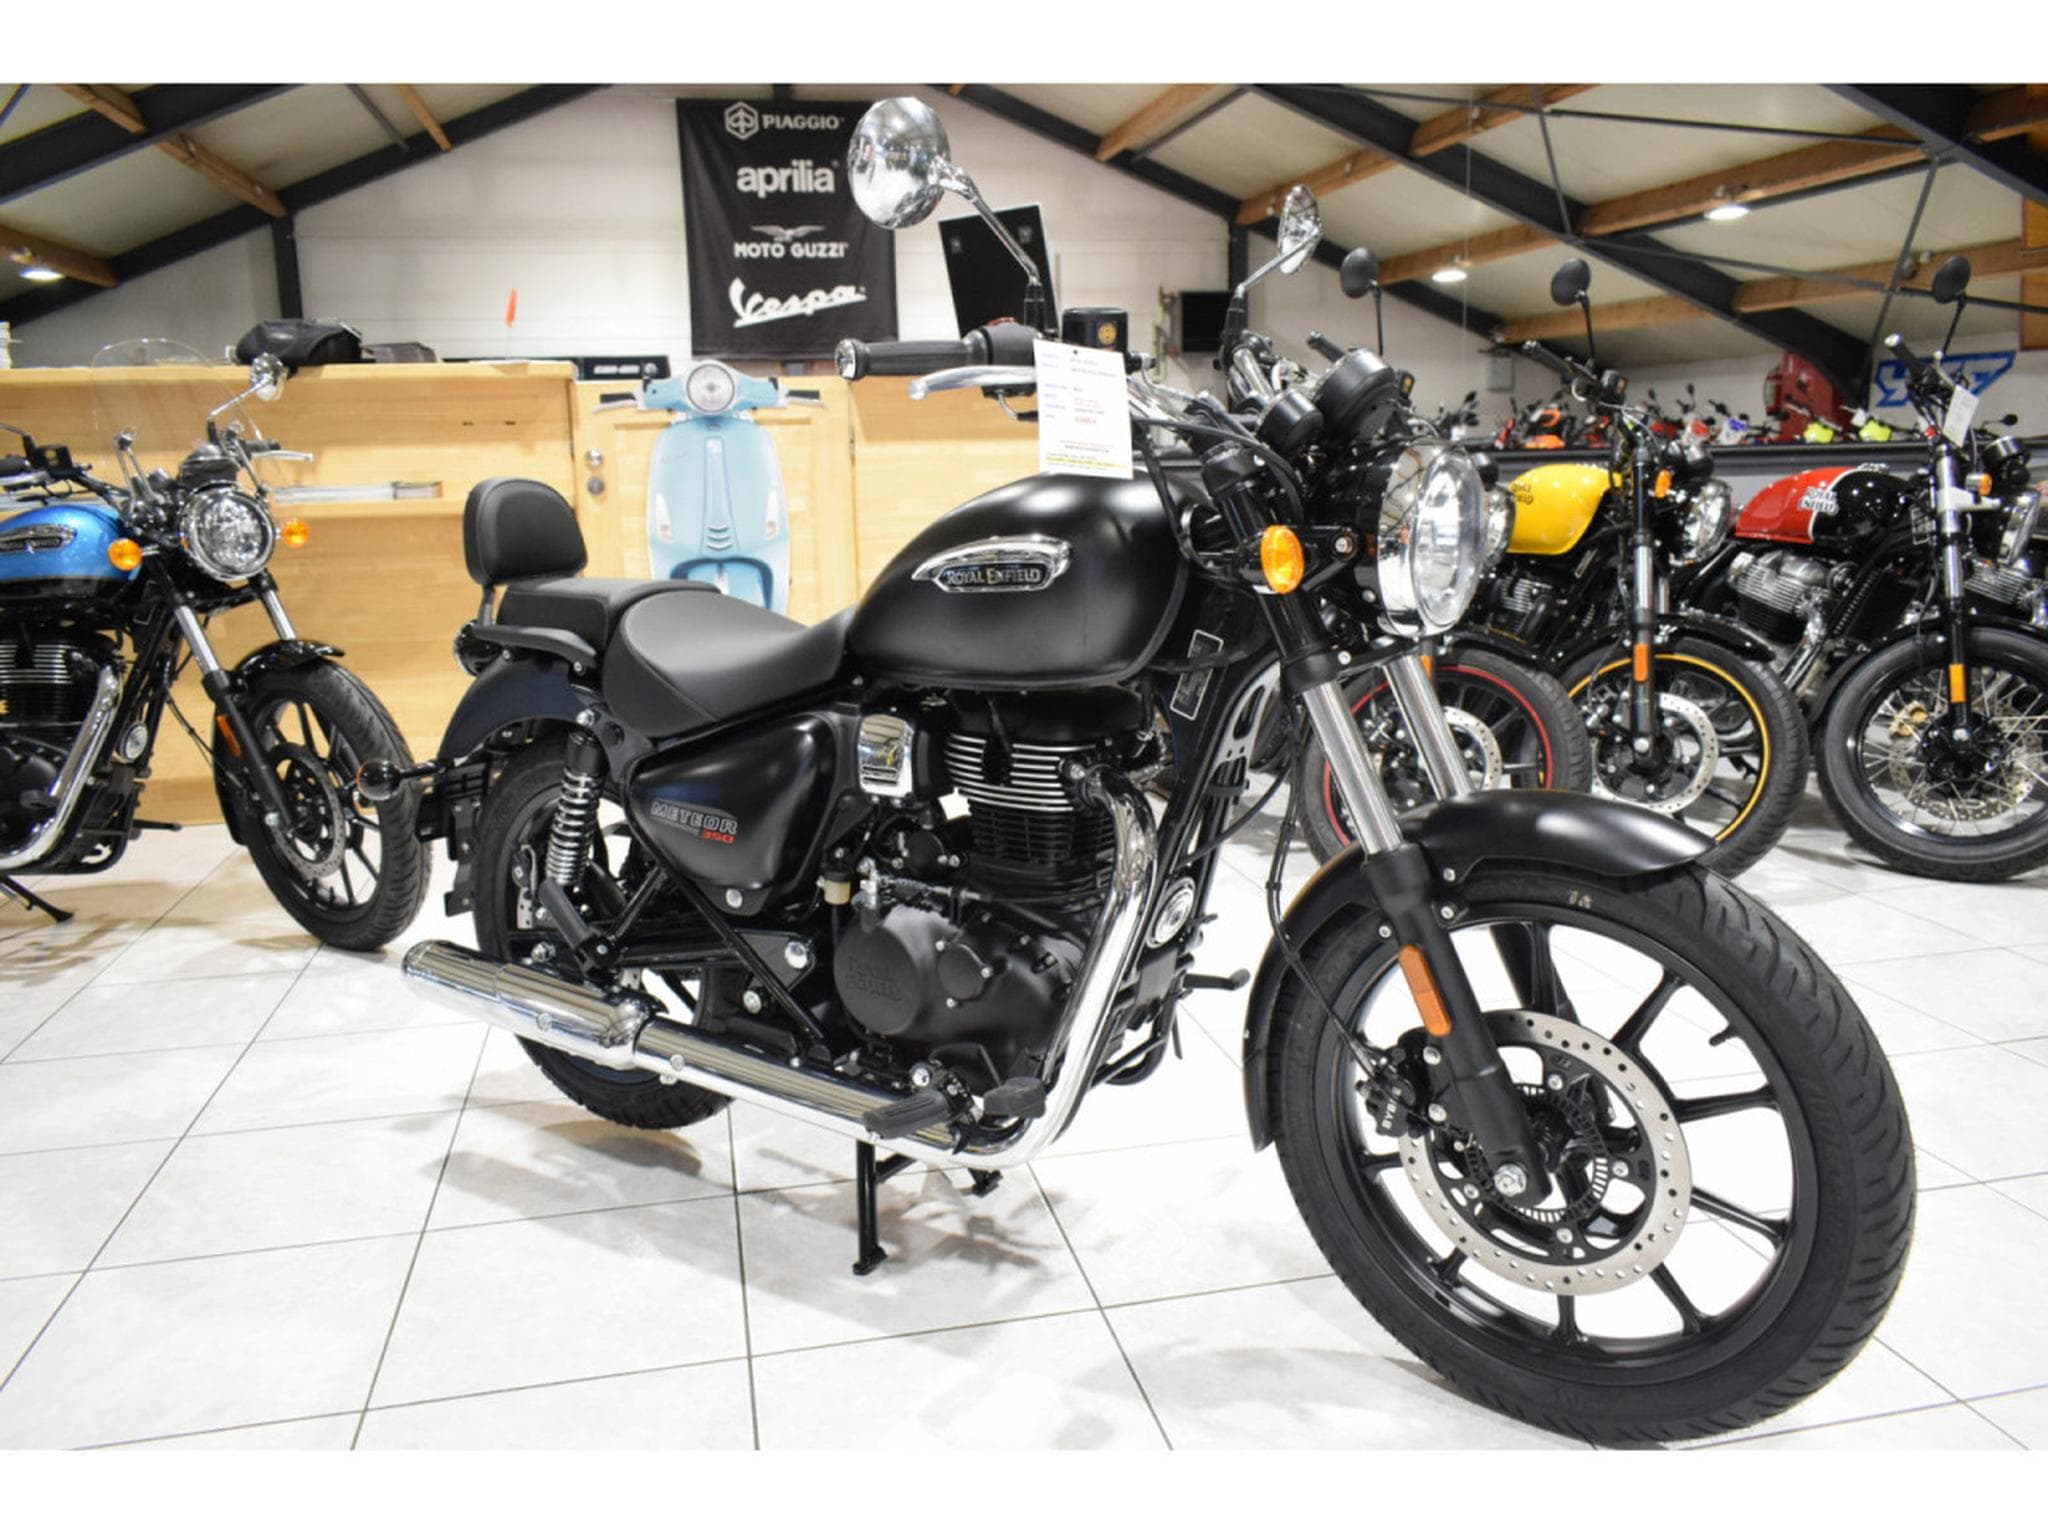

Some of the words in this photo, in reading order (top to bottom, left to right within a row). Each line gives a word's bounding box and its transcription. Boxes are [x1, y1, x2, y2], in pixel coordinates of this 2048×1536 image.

[762, 114, 840, 130] PIAGGIO
[736, 159, 836, 199] aprilia
[733, 241, 786, 259] MOTO
[790, 241, 847, 259] GUZZI
[728, 277, 867, 328] Vespa
[946, 569, 985, 586] ROYAL
[986, 566, 1042, 585] ENFIELD
[651, 801, 738, 835] METEOR
